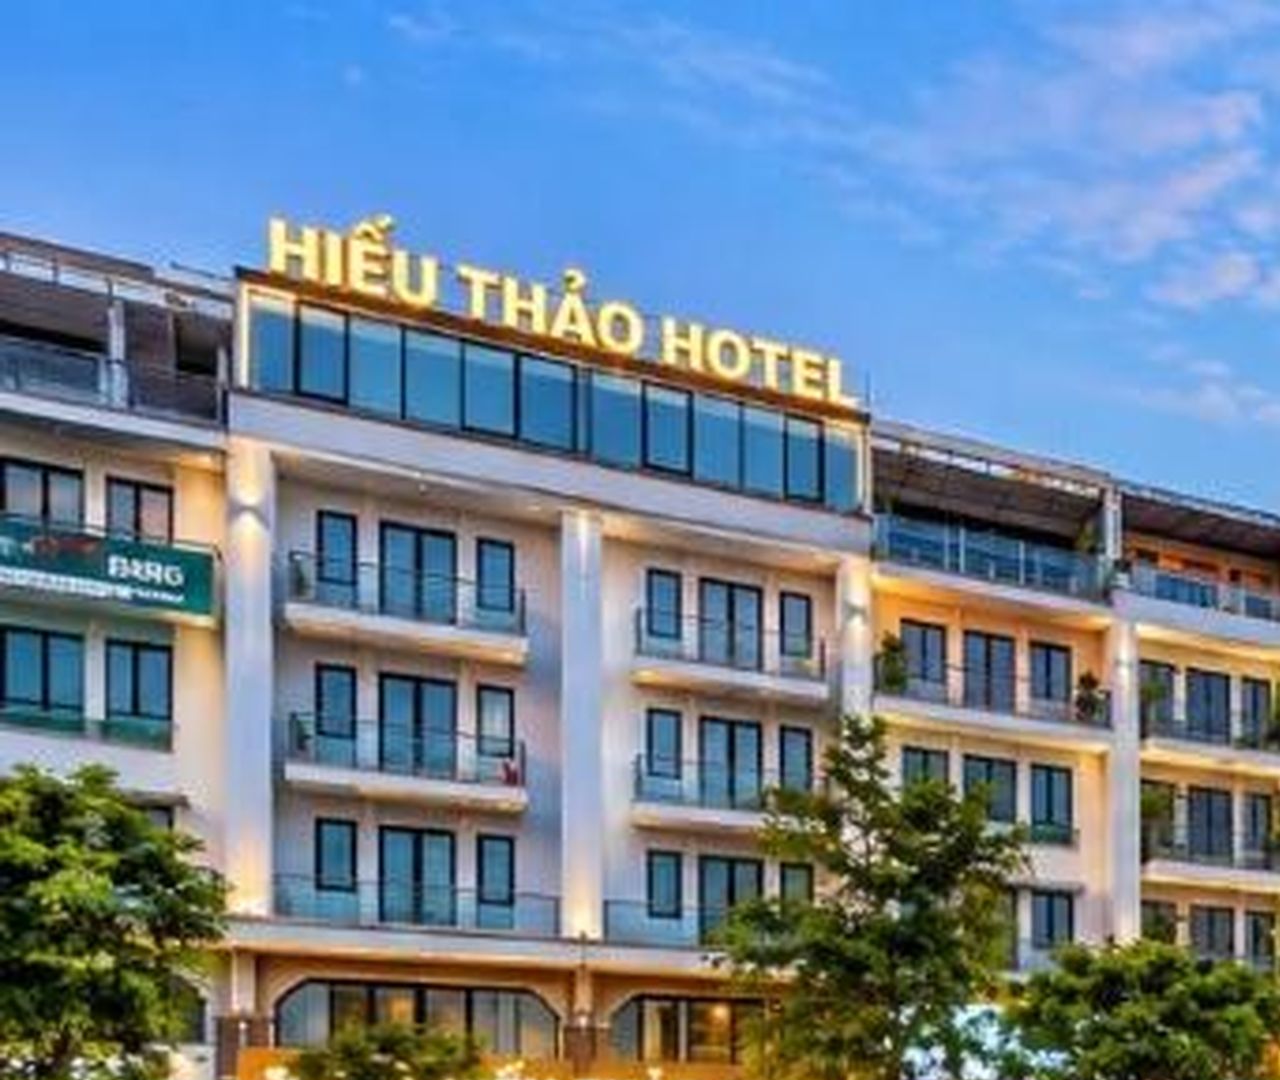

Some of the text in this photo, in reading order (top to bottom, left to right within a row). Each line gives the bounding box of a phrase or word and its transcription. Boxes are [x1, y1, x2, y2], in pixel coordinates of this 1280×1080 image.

[268, 213, 860, 406] HIẾU THẢO HOTEL
